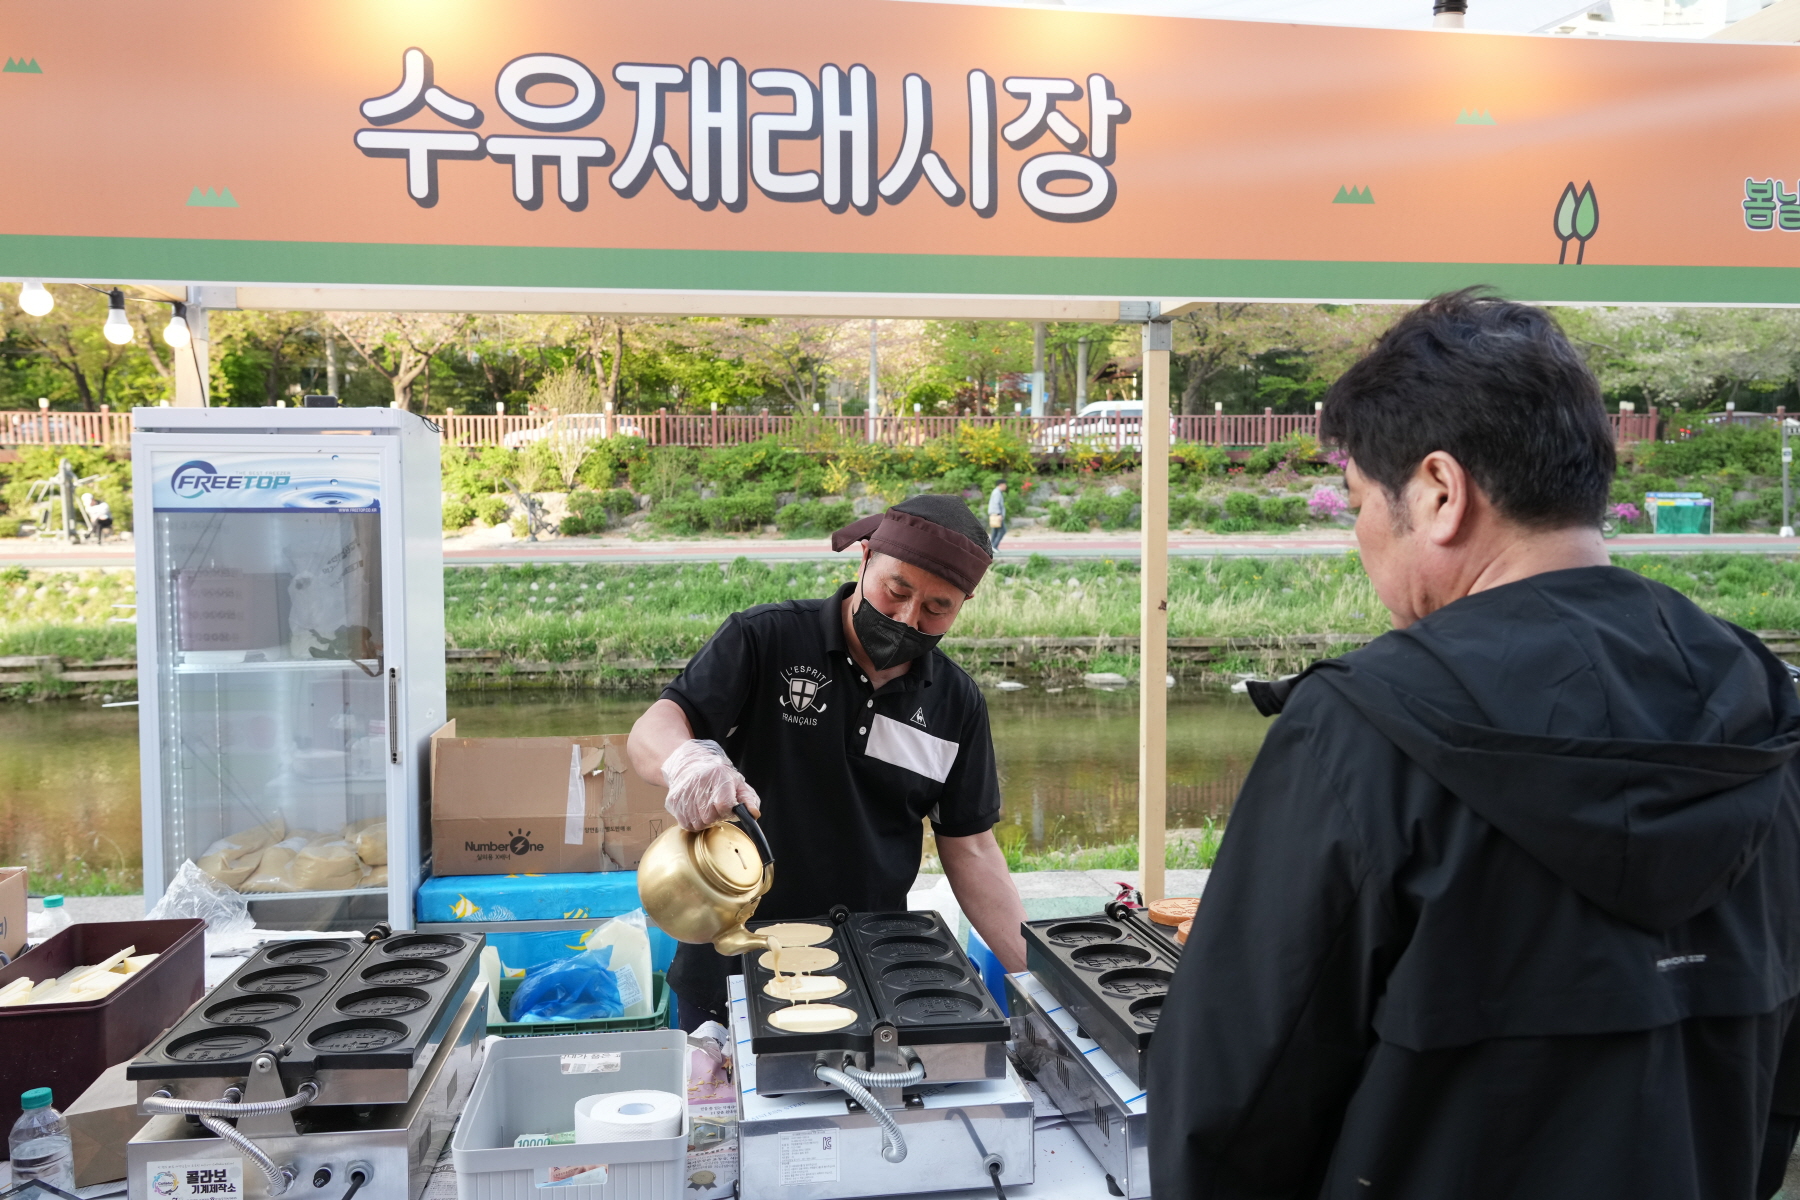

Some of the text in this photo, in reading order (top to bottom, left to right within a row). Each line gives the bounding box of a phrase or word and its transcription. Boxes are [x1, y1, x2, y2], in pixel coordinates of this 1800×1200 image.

[354, 46, 1131, 223] 수유재래시장
[177, 475, 291, 493] FREETOP
[785, 665, 827, 682] L'ESPRIT
[782, 712, 818, 727] FRANÇAIS
[186, 1169, 227, 1184] 콜라보
[191, 1183, 237, 1195] 기계제작소
